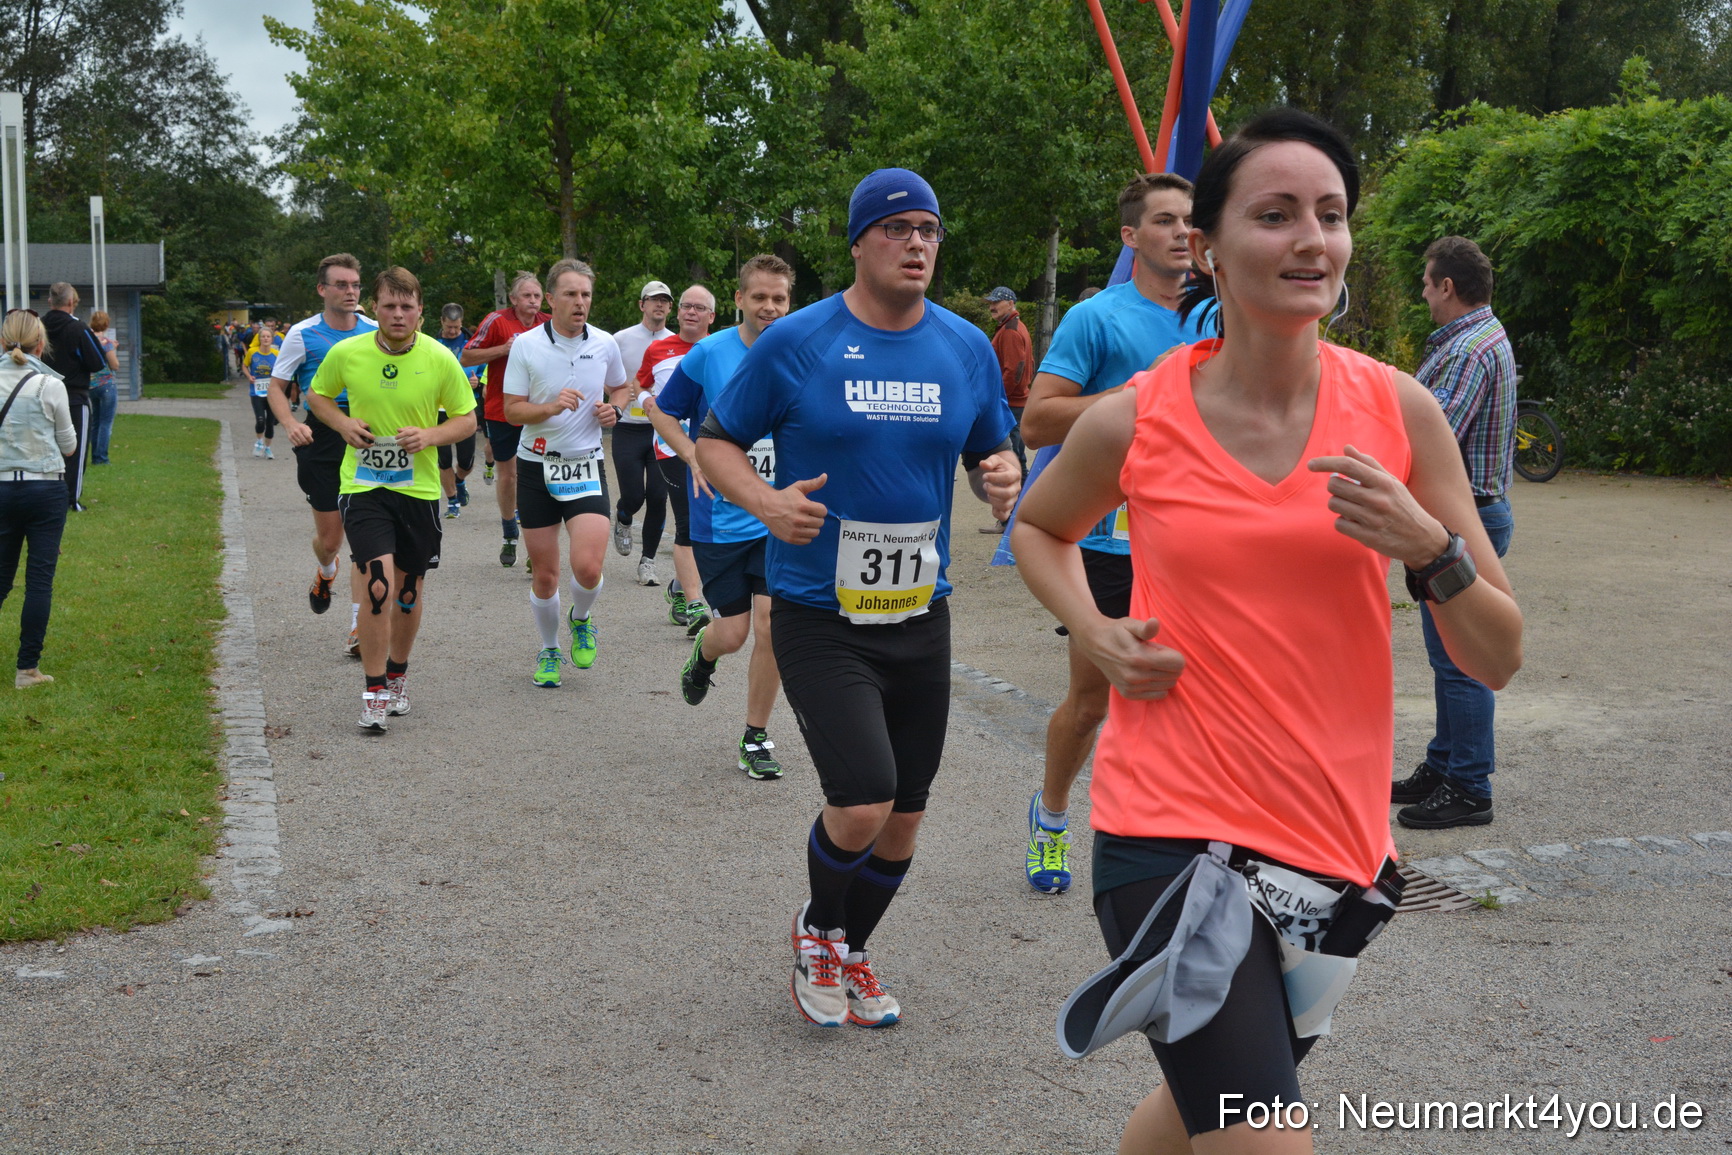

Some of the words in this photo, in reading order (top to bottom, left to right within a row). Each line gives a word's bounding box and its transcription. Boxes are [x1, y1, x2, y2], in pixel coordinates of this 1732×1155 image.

[844, 380, 942, 404] HUBER
[866, 402, 938, 413] TECHNOLOGY
[866, 413, 888, 421] WASTE
[889, 414, 911, 422] WATER
[912, 415, 939, 423] Solutions
[360, 448, 409, 468] 2528
[375, 472, 394, 482] Felix
[549, 461, 592, 481] 2041
[558, 484, 587, 494] Michael
[842, 530, 880, 543] PARTL
[883, 533, 927, 544] Neumarkt
[860, 547, 922, 586] 311
[855, 595, 918, 610] Johannes
[1247, 877, 1293, 909] PARTL
